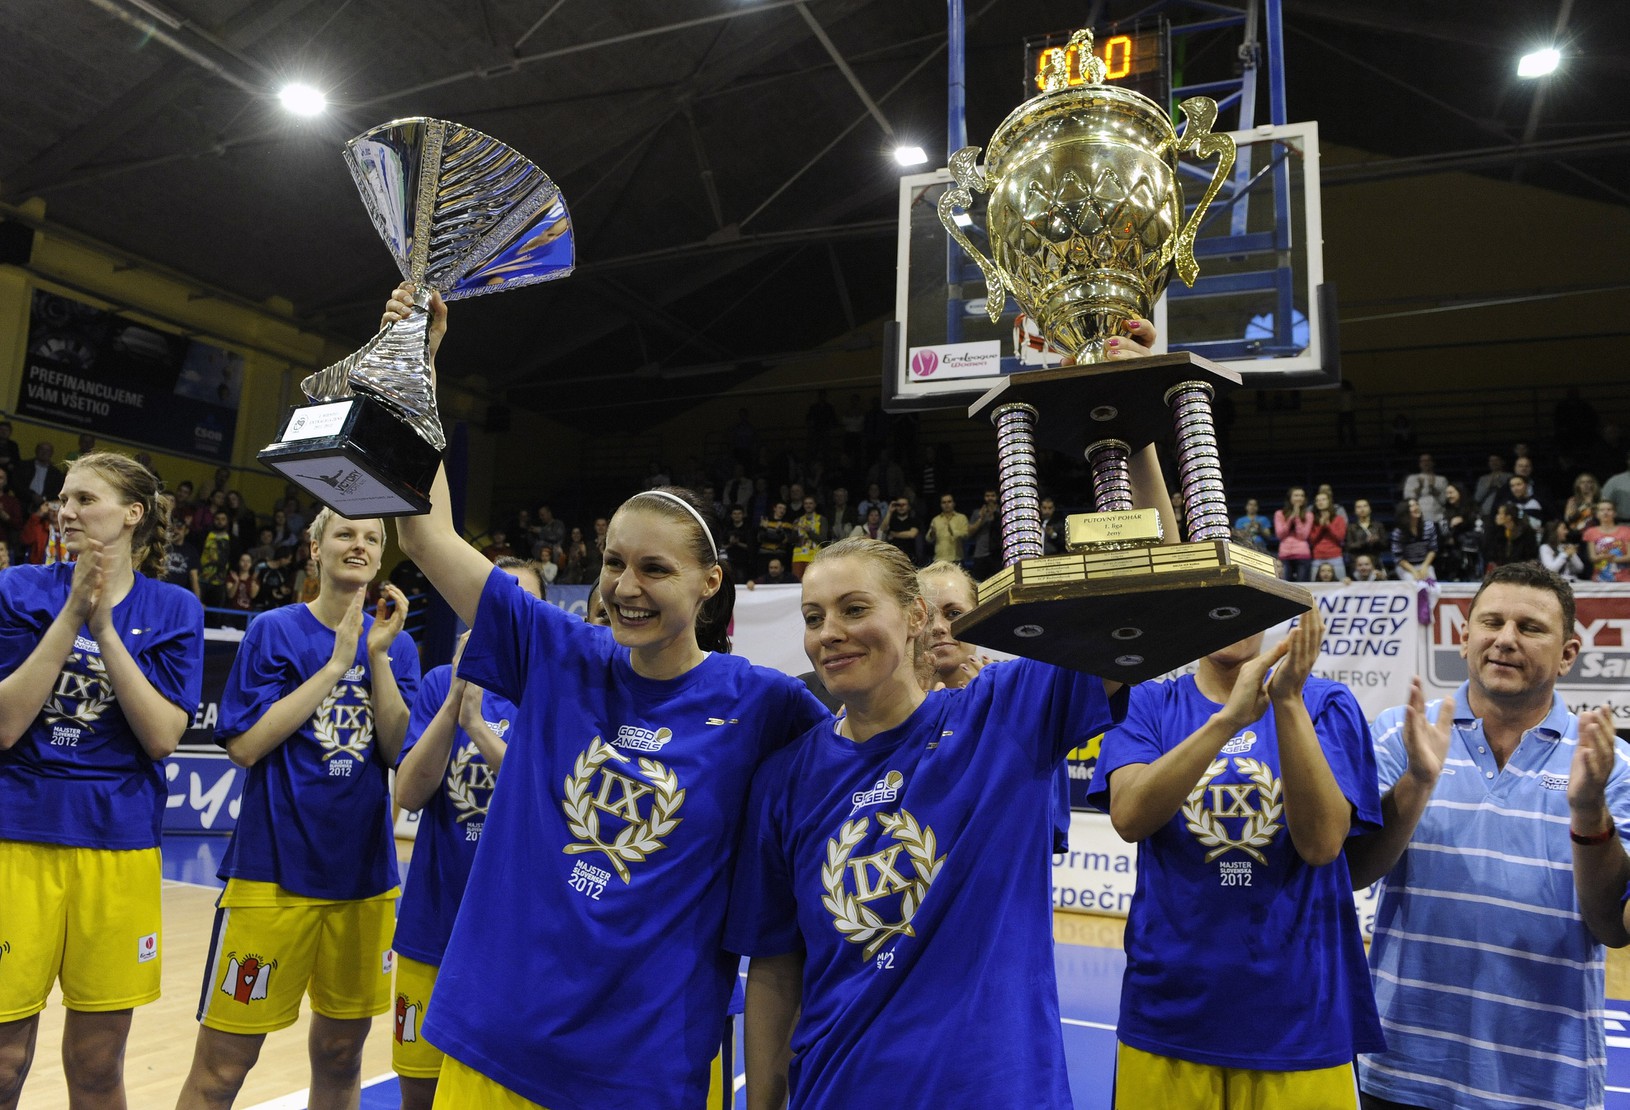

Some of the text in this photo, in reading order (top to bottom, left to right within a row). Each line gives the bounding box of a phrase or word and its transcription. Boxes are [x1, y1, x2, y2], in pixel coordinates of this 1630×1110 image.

[30, 365, 144, 408] PREFINANCUJEME
[28, 382, 58, 404] VÁM
[61, 391, 110, 416] VŠETKO
[1315, 596, 1409, 613] NITED
[1287, 618, 1407, 635] EERGY
[1320, 640, 1402, 656] ADING
[55, 671, 98, 699] IX
[1311, 671, 1391, 687] NERGY
[333, 704, 367, 729] IX
[50, 735, 79, 747] 2012
[619, 726, 655, 740] GOOD
[612, 737, 662, 750] ANGELS
[329, 767, 352, 777] 2012
[1542, 774, 1569, 785] GOOD
[591, 767, 654, 823] IX
[1208, 784, 1257, 817] IX
[576, 859, 611, 881] MAJSTER
[848, 844, 912, 901] IX
[1220, 861, 1252, 869] MAJSTER
[572, 867, 607, 886] SLOVENSKA
[1220, 873, 1252, 886] 2012
[568, 873, 604, 900] 2012
